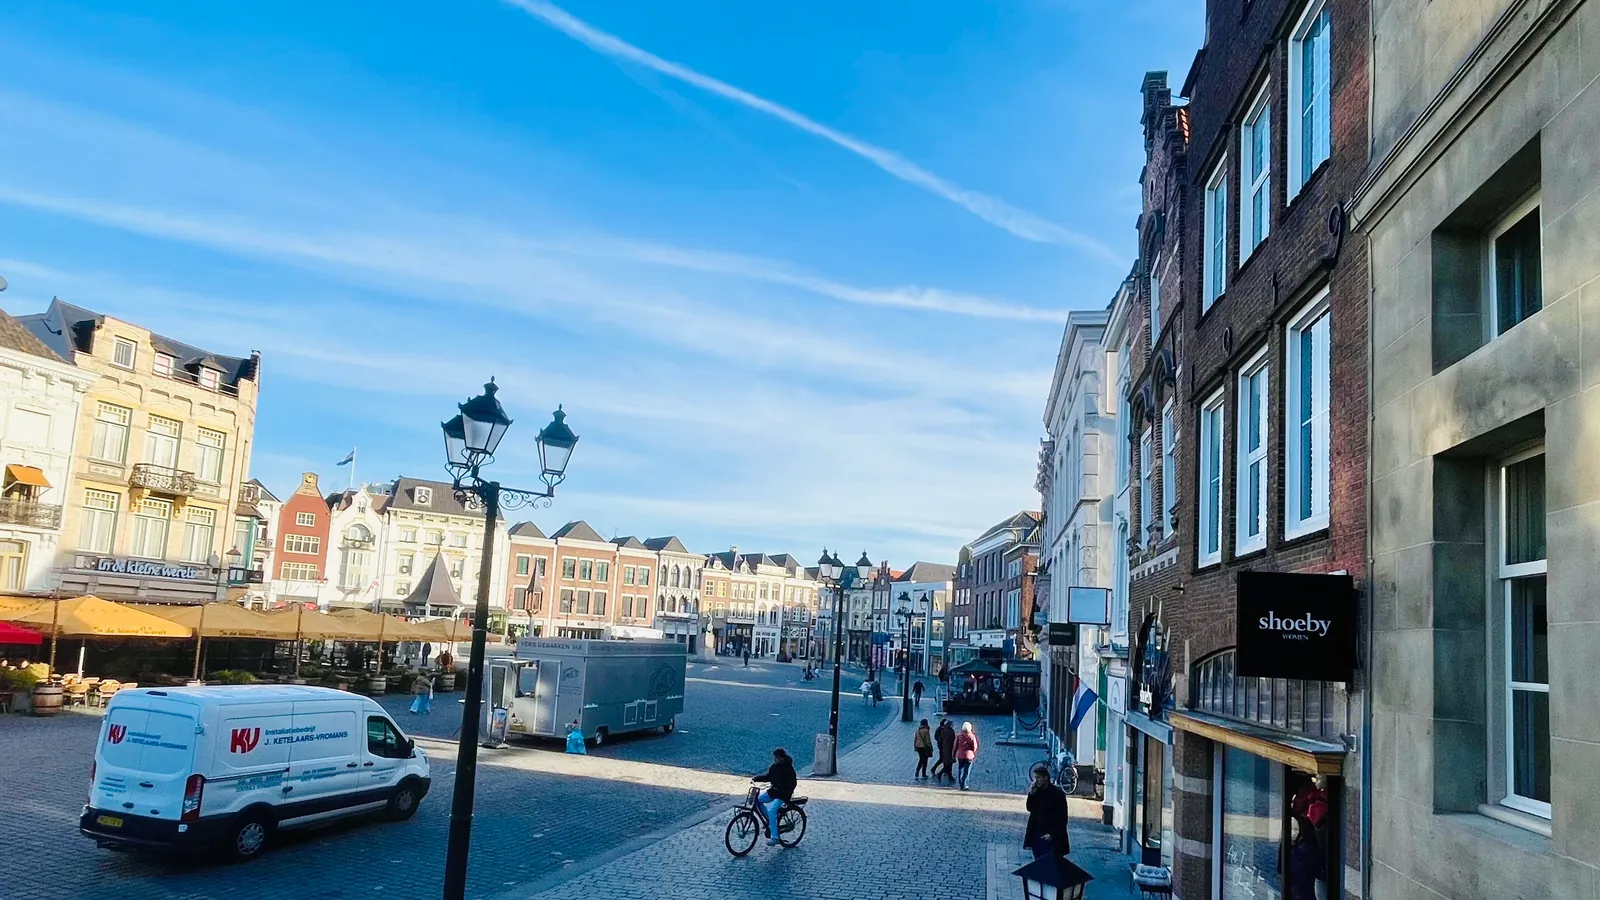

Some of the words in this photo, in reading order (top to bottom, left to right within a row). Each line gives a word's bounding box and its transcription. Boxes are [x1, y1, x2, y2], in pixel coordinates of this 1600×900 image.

[112, 559, 125, 572] de
[127, 560, 161, 575] kleine
[1259, 611, 1331, 637] shoeby
[264, 738, 271, 746] J.
[273, 731, 348, 745] KETELAARS-VROMANS
[265, 726, 316, 736] Installatiebedrijf
[230, 728, 260, 754] KV
